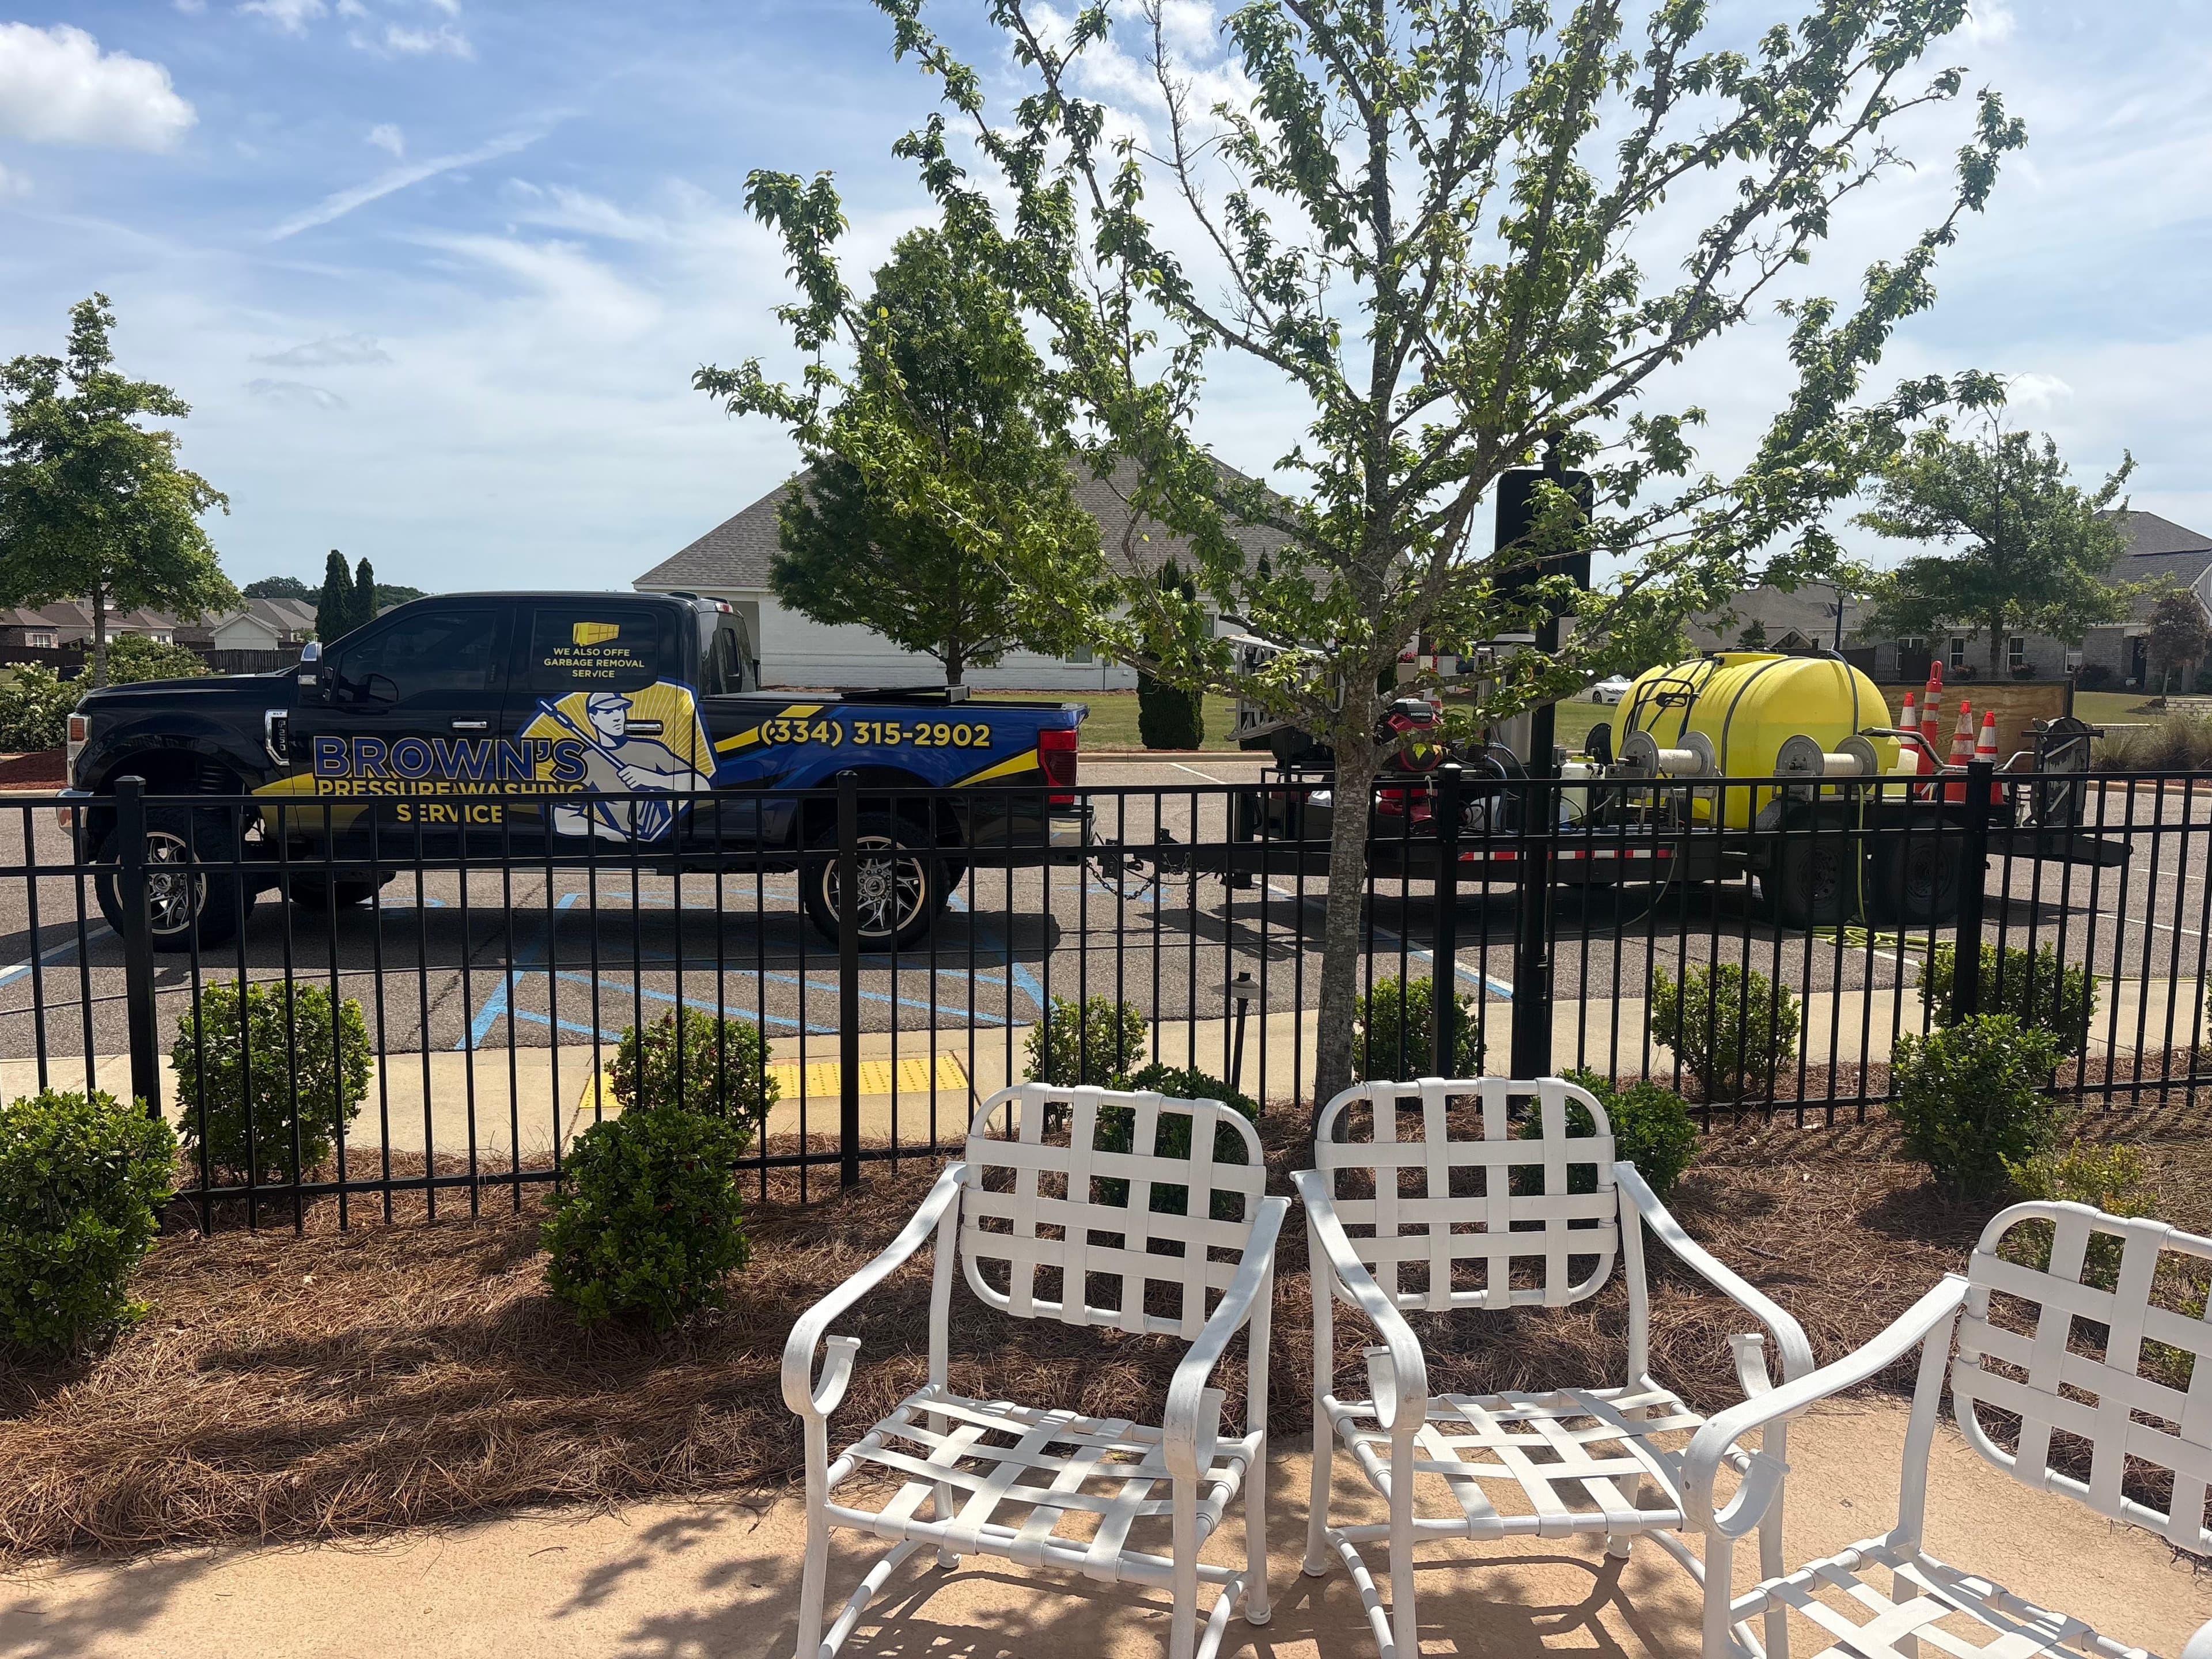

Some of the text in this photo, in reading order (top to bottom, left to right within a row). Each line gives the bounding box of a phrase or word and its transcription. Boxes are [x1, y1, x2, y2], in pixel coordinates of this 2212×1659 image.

[553, 647, 630, 657] WE ALSO OFFE
[544, 658, 645, 668] GARBAGE REMOVAL
[572, 669, 615, 678] SERVICE
[760, 719, 990, 747] (334) 315-2902
[313, 736, 588, 782] BROWN'S
[317, 779, 451, 796] PRESSURE
[396, 804, 502, 824] SERVICE
